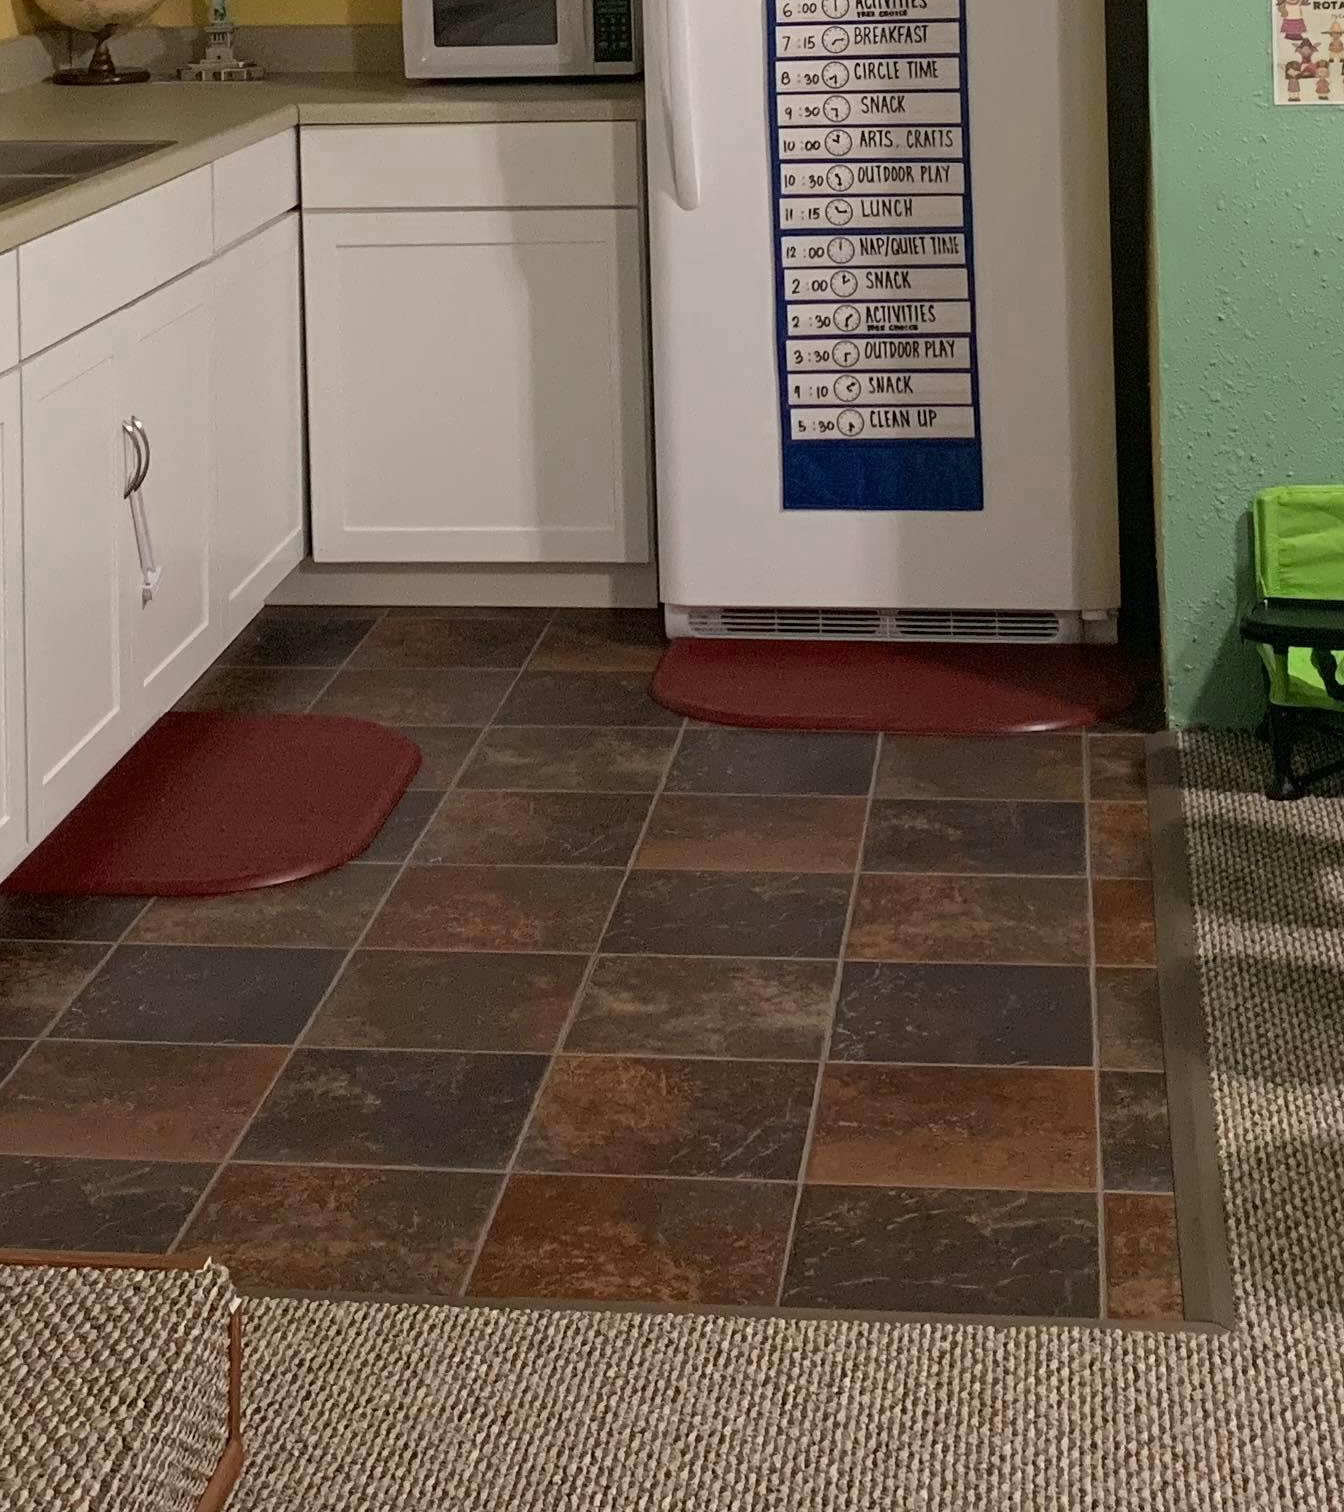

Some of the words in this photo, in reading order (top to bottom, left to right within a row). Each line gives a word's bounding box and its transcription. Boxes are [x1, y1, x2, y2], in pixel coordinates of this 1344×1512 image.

[854, 25, 928, 45] BREAKFAST
[854, 62, 900, 79] CIRCLE
[908, 60, 939, 78] TIME
[861, 96, 906, 114] SNACK
[906, 130, 953, 148] CRAFTS
[858, 165, 914, 183] OUTDOOR
[921, 165, 950, 182] PLAY
[861, 198, 912, 218] LUNCH
[860, 237, 927, 257] NAP/QUIET
[866, 271, 912, 289] SNACK
[866, 305, 936, 323] ACTIVITIES
[865, 342, 920, 359] OUTDOOR
[925, 340, 955, 358] PLAY
[868, 376, 914, 394] SNACK
[870, 411, 910, 428] CLEAN
[918, 410, 937, 427] UP
